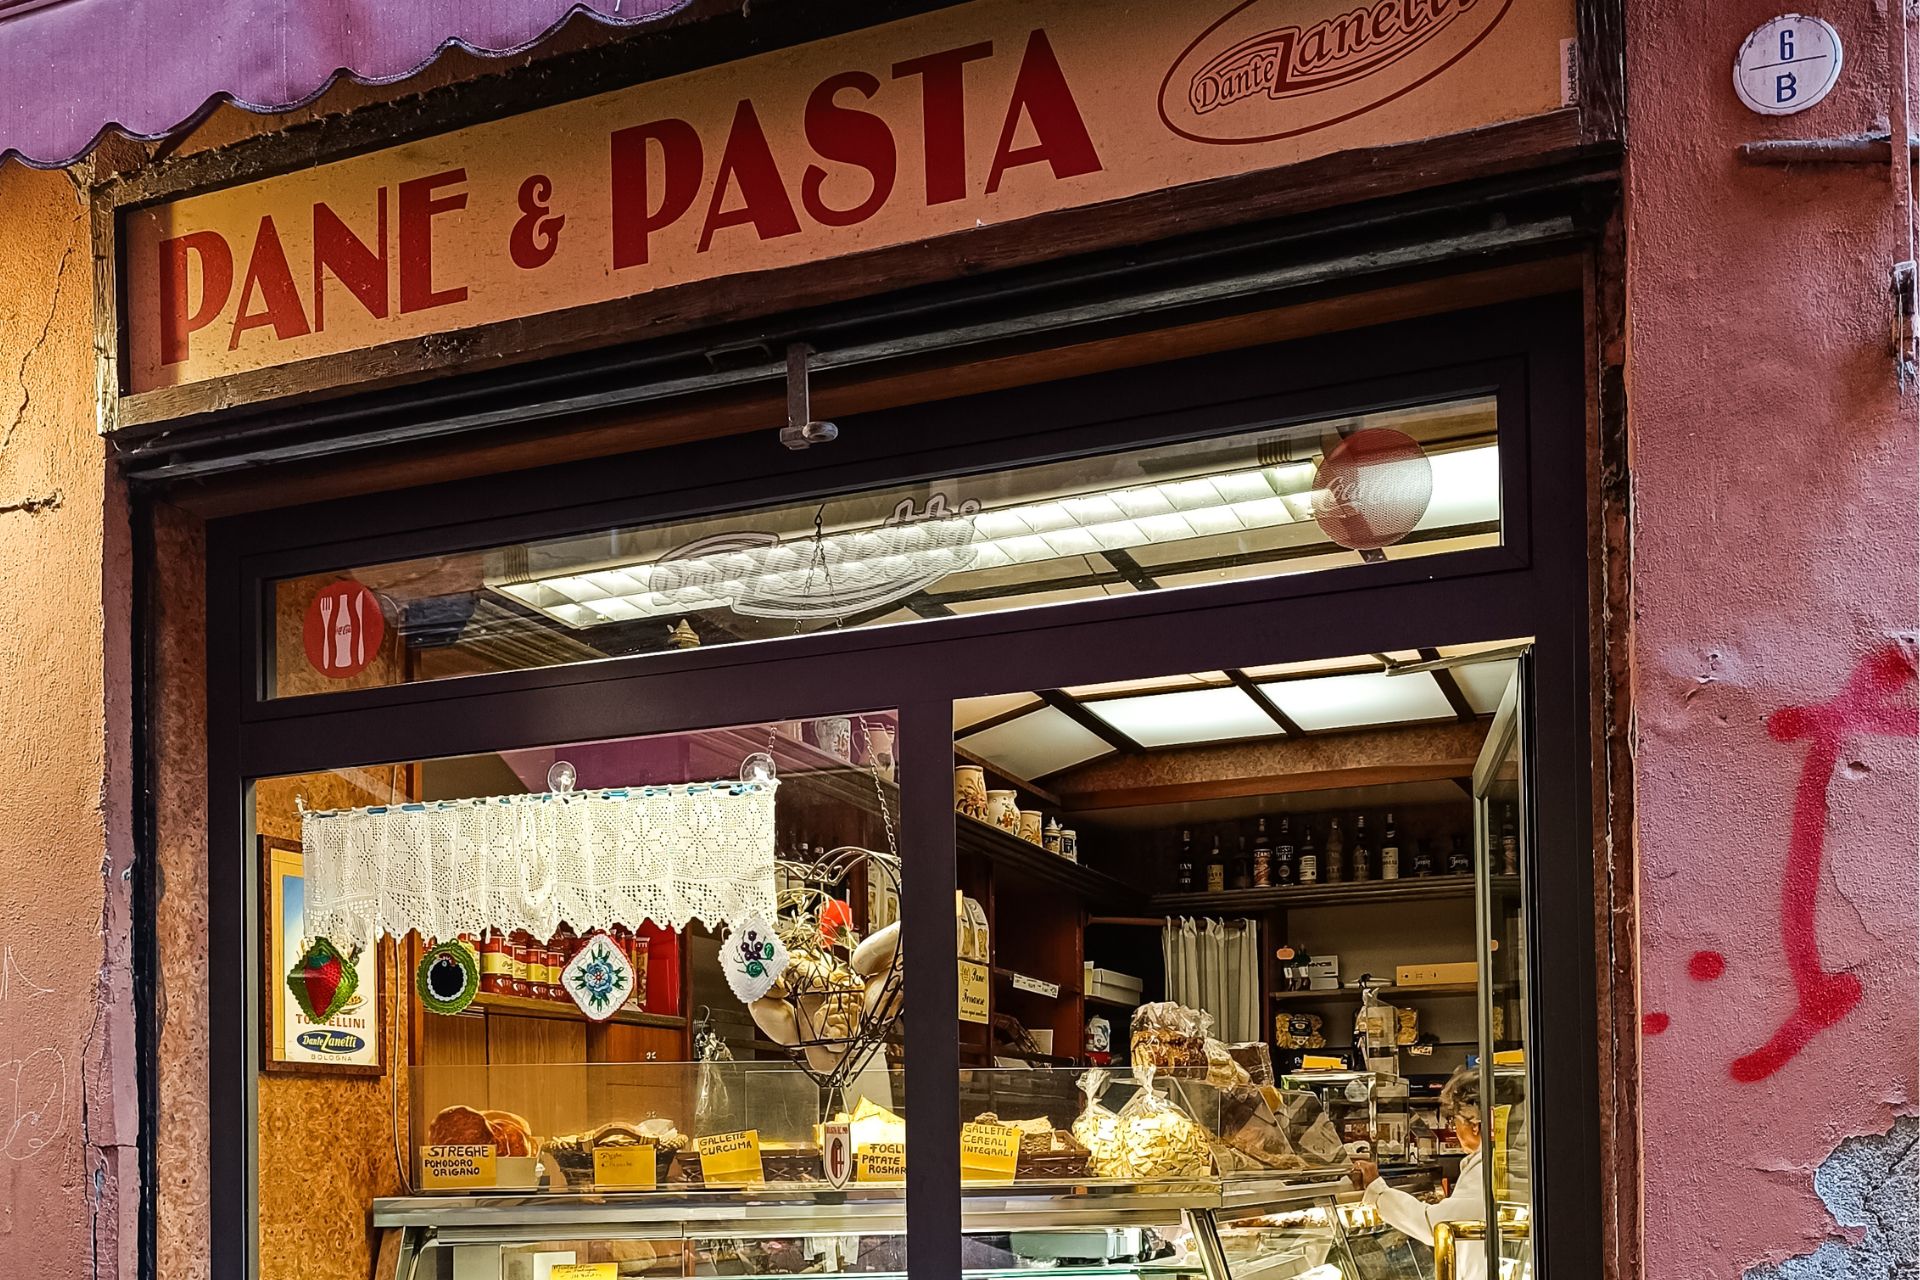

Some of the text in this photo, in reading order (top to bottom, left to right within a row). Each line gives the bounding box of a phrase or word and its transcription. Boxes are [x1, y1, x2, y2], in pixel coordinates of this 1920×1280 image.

[1779, 29, 1794, 61] 6
[1197, 0, 1478, 109] Dante Zanet
[1776, 71, 1797, 103] B
[159, 27, 1103, 366] PANE & PASTA
[295, 1013, 366, 1029] TOELLINI
[302, 1032, 358, 1053] Dante Zanetti
[310, 1054, 352, 1062] BOLOGNA
[964, 1124, 1013, 1137] GALLETTE
[699, 1132, 746, 1147] GALLETTE
[962, 1134, 1007, 1147] CEREALI
[427, 1146, 490, 1158] STREGHE
[700, 1140, 752, 1156] CURCUMA
[963, 1144, 1014, 1157] INTEGRALI
[424, 1159, 473, 1168] POMODORO
[861, 1154, 901, 1166] PATATE
[432, 1167, 480, 1177] ORIGANO
